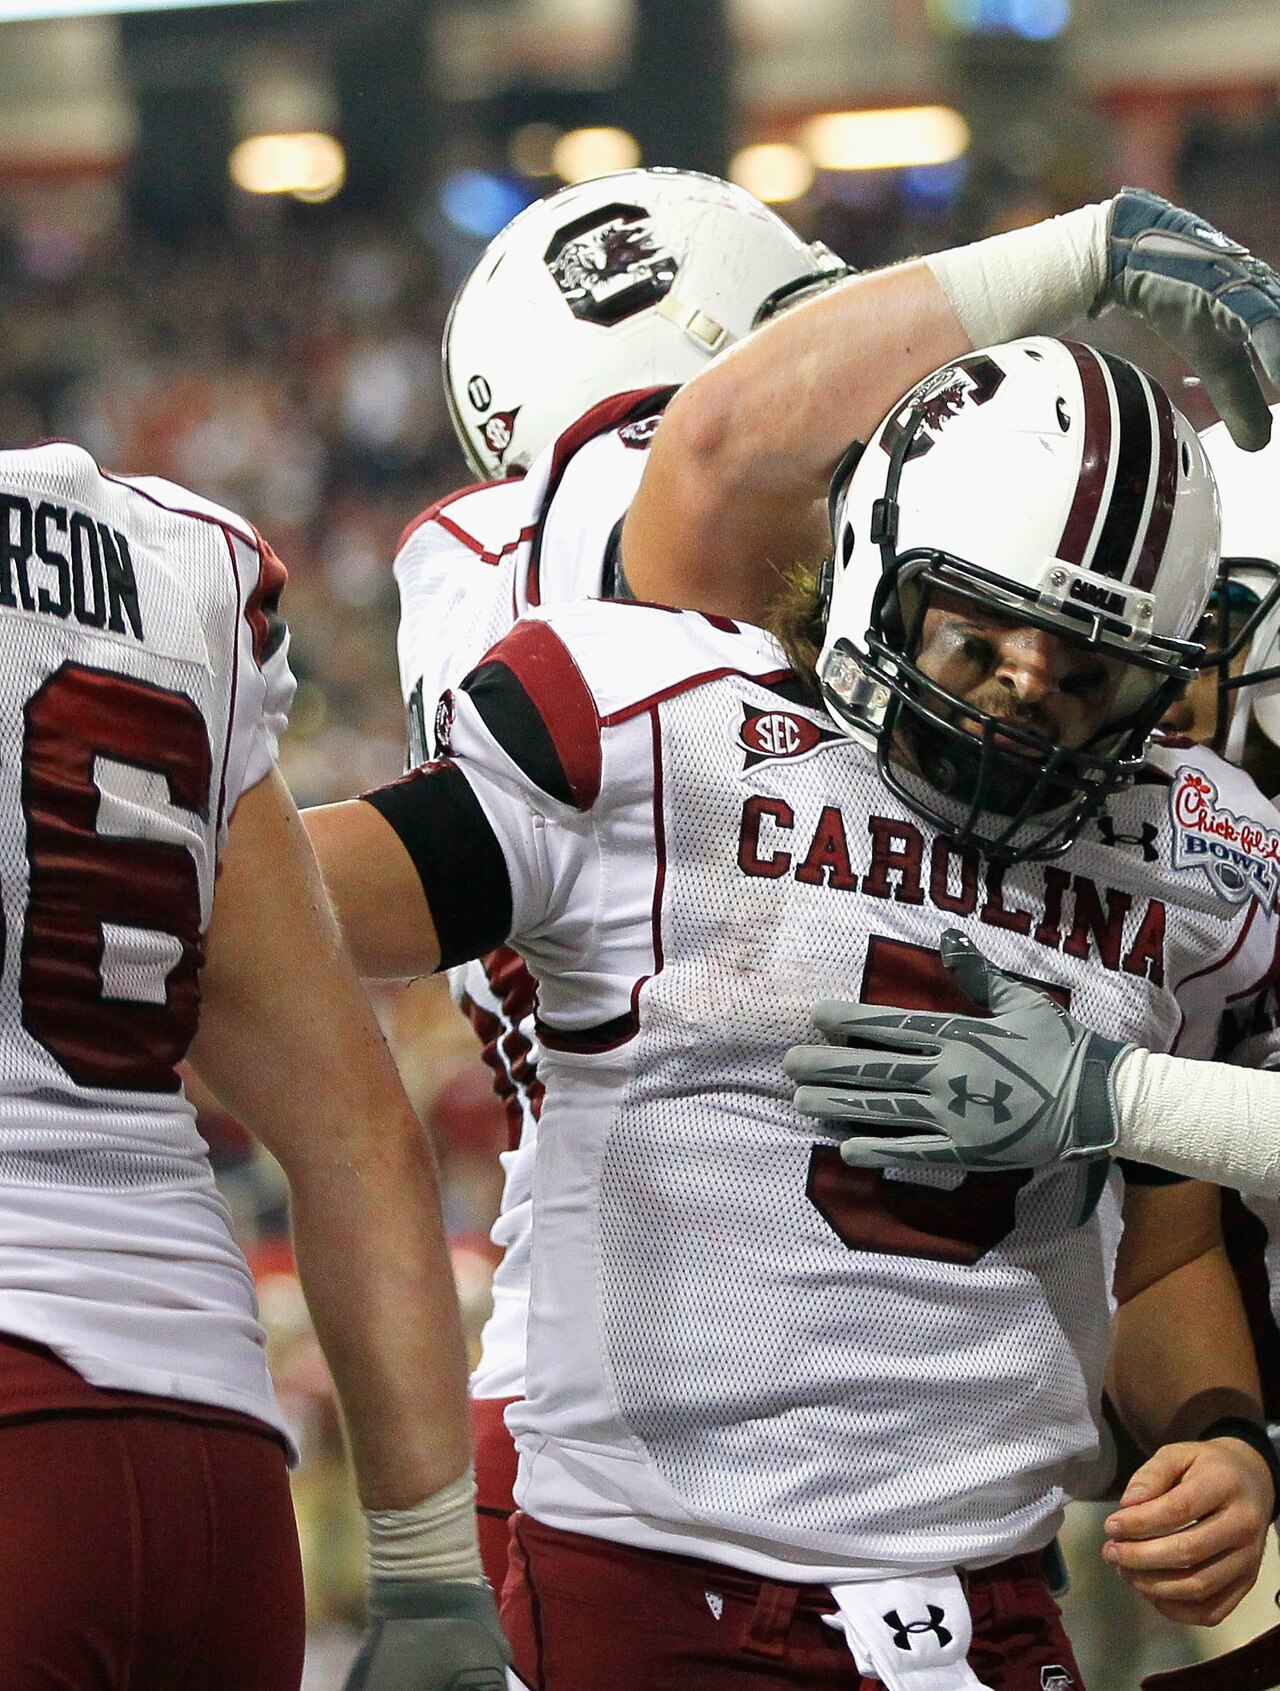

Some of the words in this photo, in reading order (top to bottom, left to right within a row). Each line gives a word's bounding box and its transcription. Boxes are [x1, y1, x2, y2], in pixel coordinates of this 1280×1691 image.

[0, 492, 145, 642] RSON
[755, 714, 801, 754] SEC
[20, 660, 213, 1092] 6
[737, 794, 1167, 988] CAROLINA
[1184, 833, 1272, 891] BOWL
